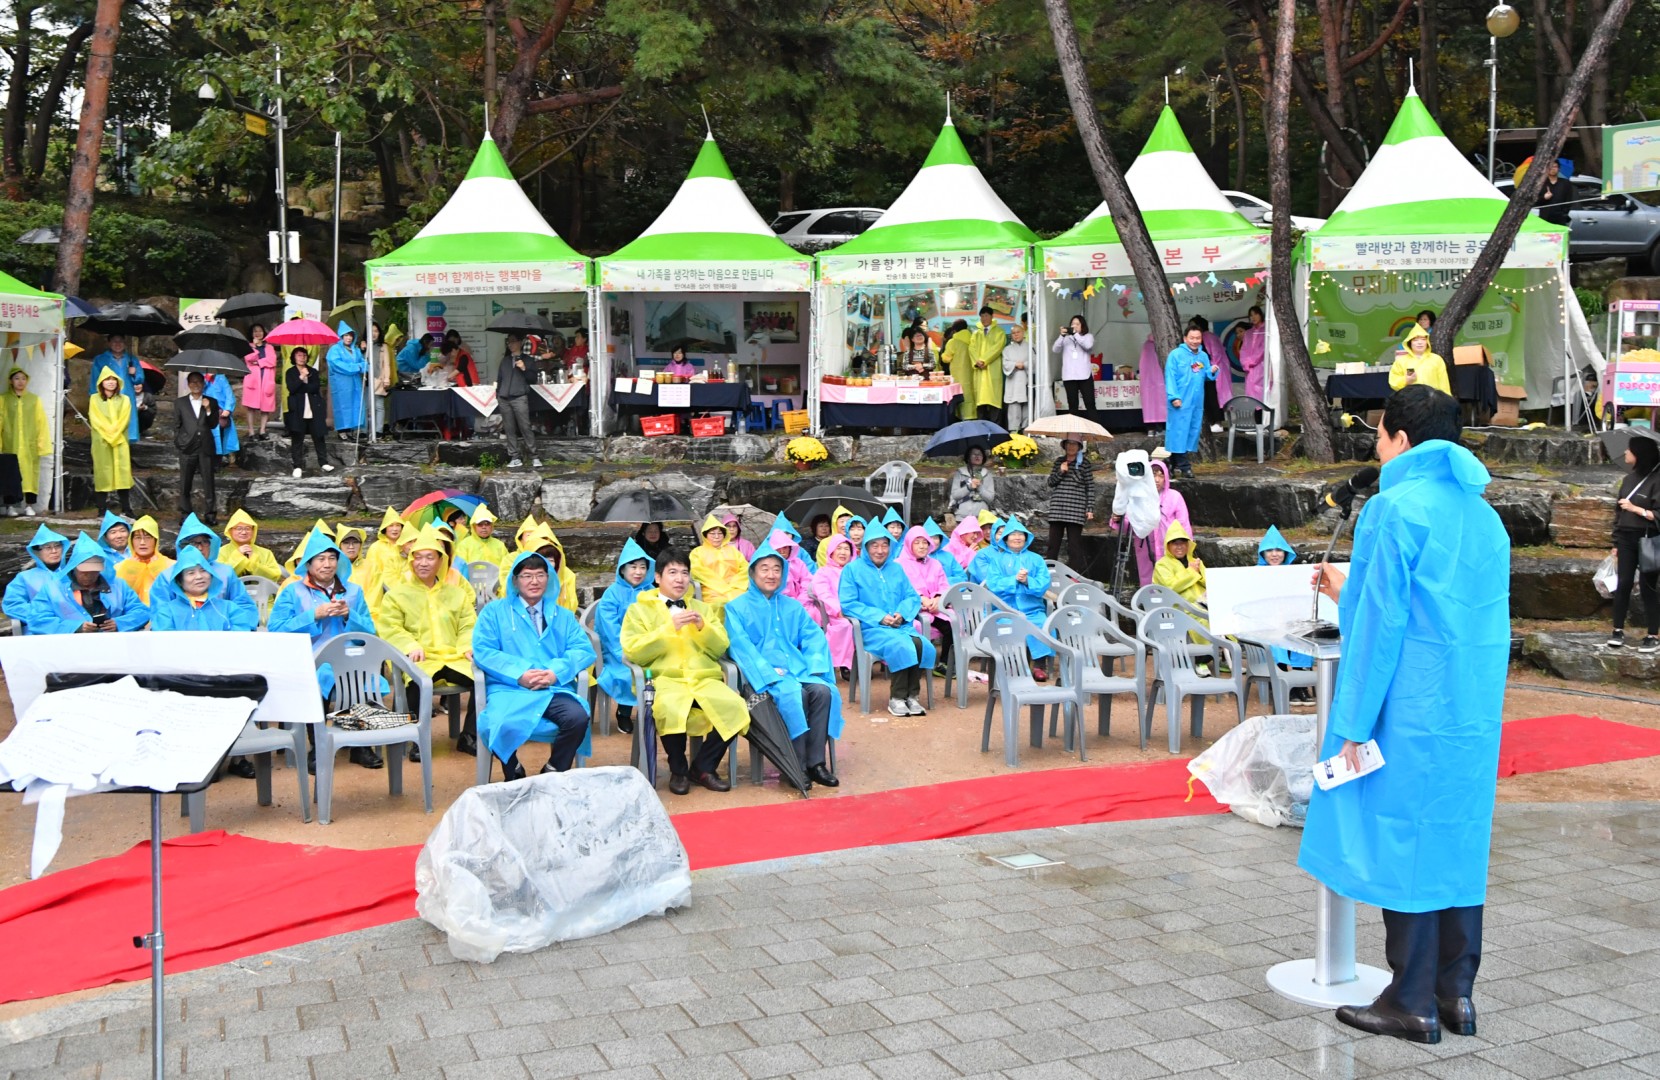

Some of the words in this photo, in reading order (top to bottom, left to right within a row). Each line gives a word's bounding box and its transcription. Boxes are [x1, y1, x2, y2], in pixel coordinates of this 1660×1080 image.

[1355, 241, 1406, 255] 빨래방과
[1410, 241, 1461, 255] 함께하는
[857, 257, 907, 272] 가을향기
[915, 256, 952, 270] 뿜내는
[960, 255, 985, 267] 카페
[416, 271, 449, 285] 더불어
[452, 270, 496, 284] 함께하는
[499, 269, 543, 283] 행복마을
[637, 269, 645, 280] 내
[647, 269, 671, 281] 가족을
[674, 268, 706, 281] 생각하는
[708, 268, 740, 281] 마음으로
[742, 268, 774, 281] 만듭니다
[2, 302, 39, 318] 힐링하세요
